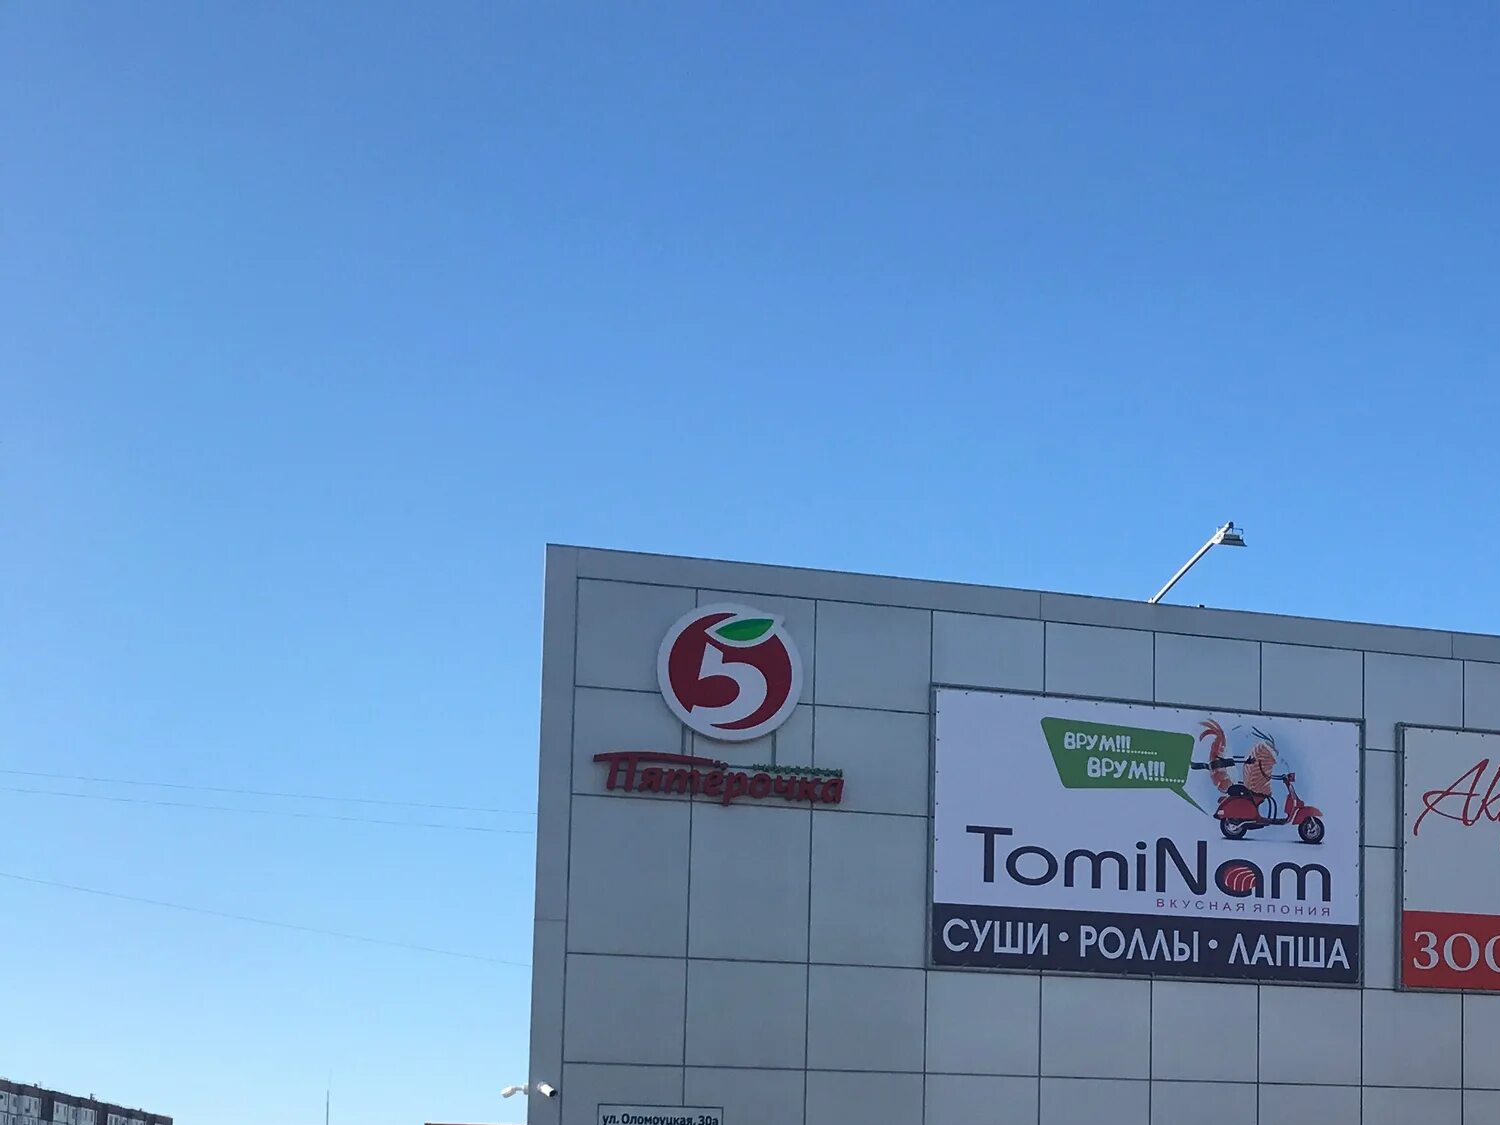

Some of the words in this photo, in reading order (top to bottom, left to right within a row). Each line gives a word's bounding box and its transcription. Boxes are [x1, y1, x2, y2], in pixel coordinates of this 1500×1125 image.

[690, 642, 768, 729] 5
[593, 752, 846, 806] Пятёрочка
[965, 824, 1332, 903] TomiNam
[1156, 898, 1246, 912] ВКУСНАЯ
[1253, 904, 1331, 917] ЯПОНИЯ
[942, 917, 1050, 956] СУШИ
[1079, 925, 1200, 963] РОЛЛЫ
[1228, 933, 1350, 970] ЛАПША
[602, 1114, 619, 1125] ул.
